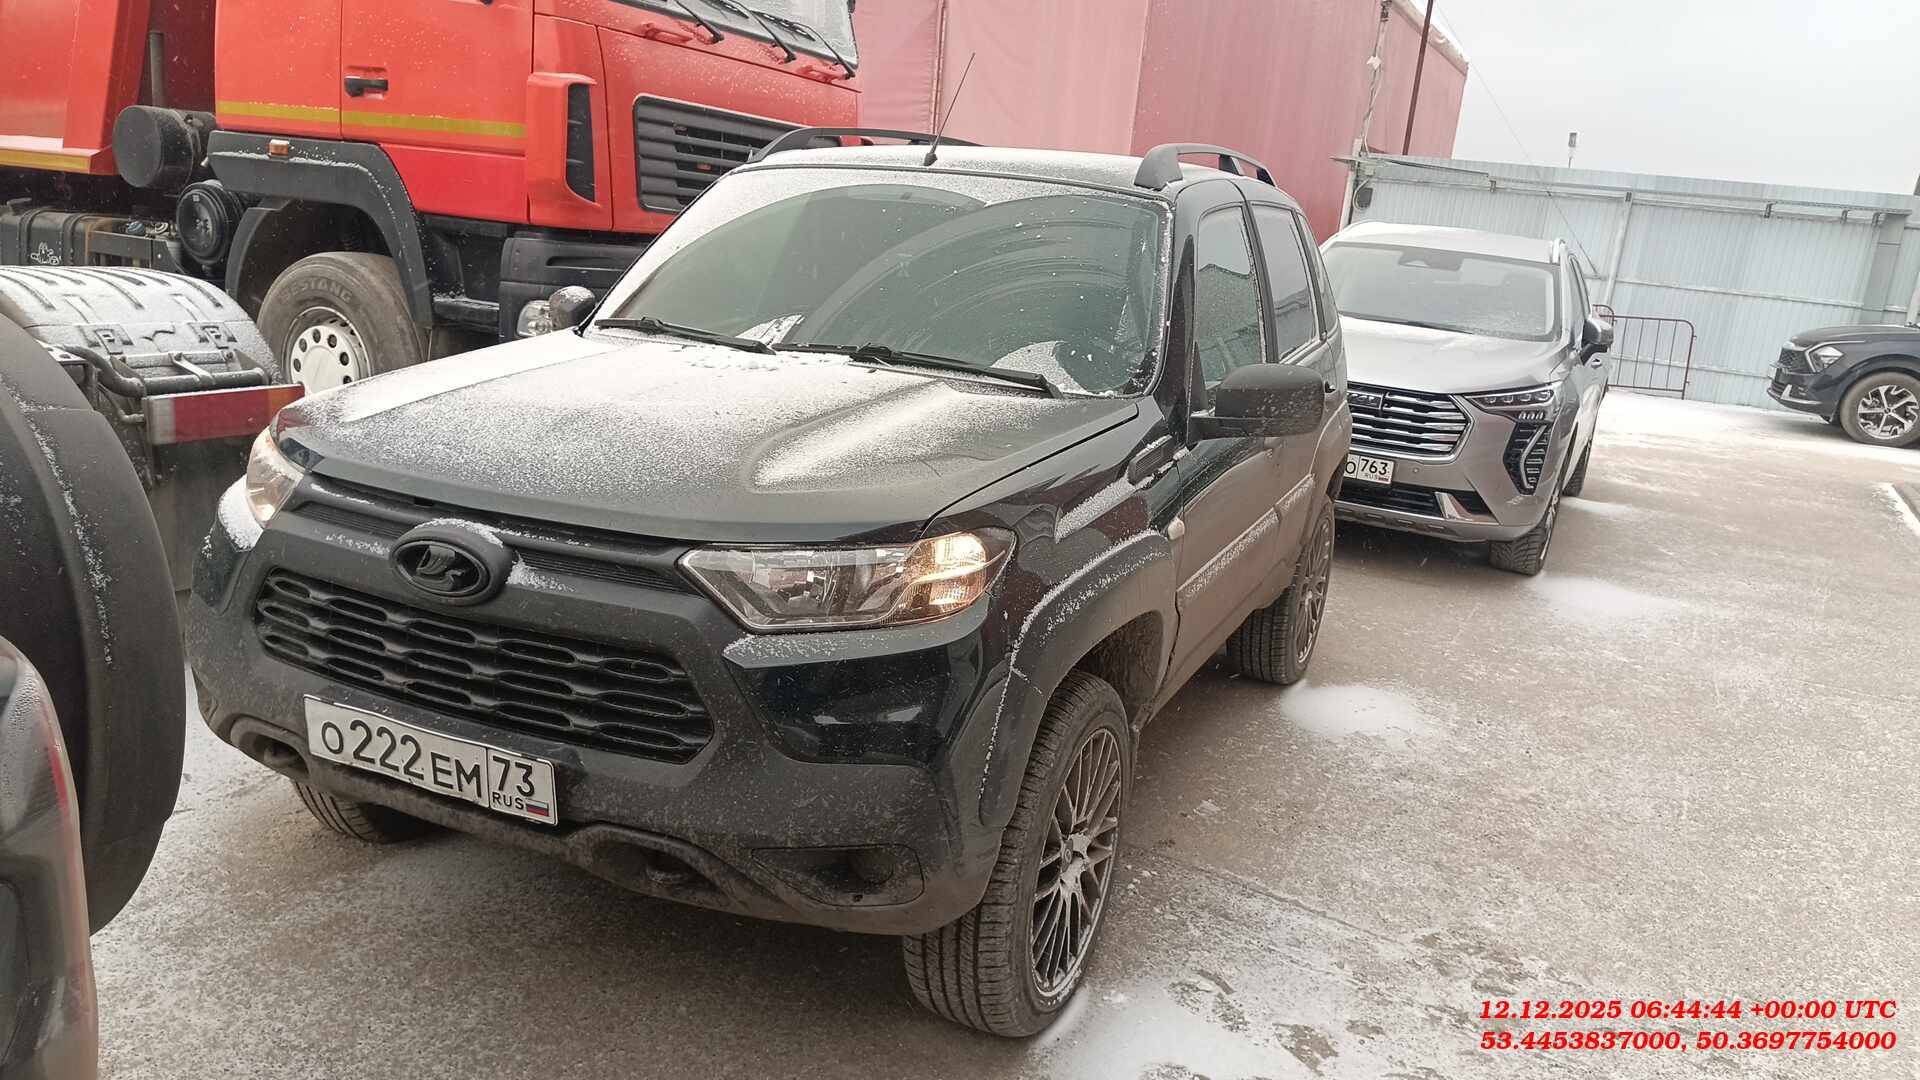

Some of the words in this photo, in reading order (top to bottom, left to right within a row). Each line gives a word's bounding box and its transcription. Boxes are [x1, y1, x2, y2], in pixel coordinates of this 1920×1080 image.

[1361, 458, 1388, 475] 763
[492, 755, 535, 797] 73
[492, 791, 525, 810] RUS
